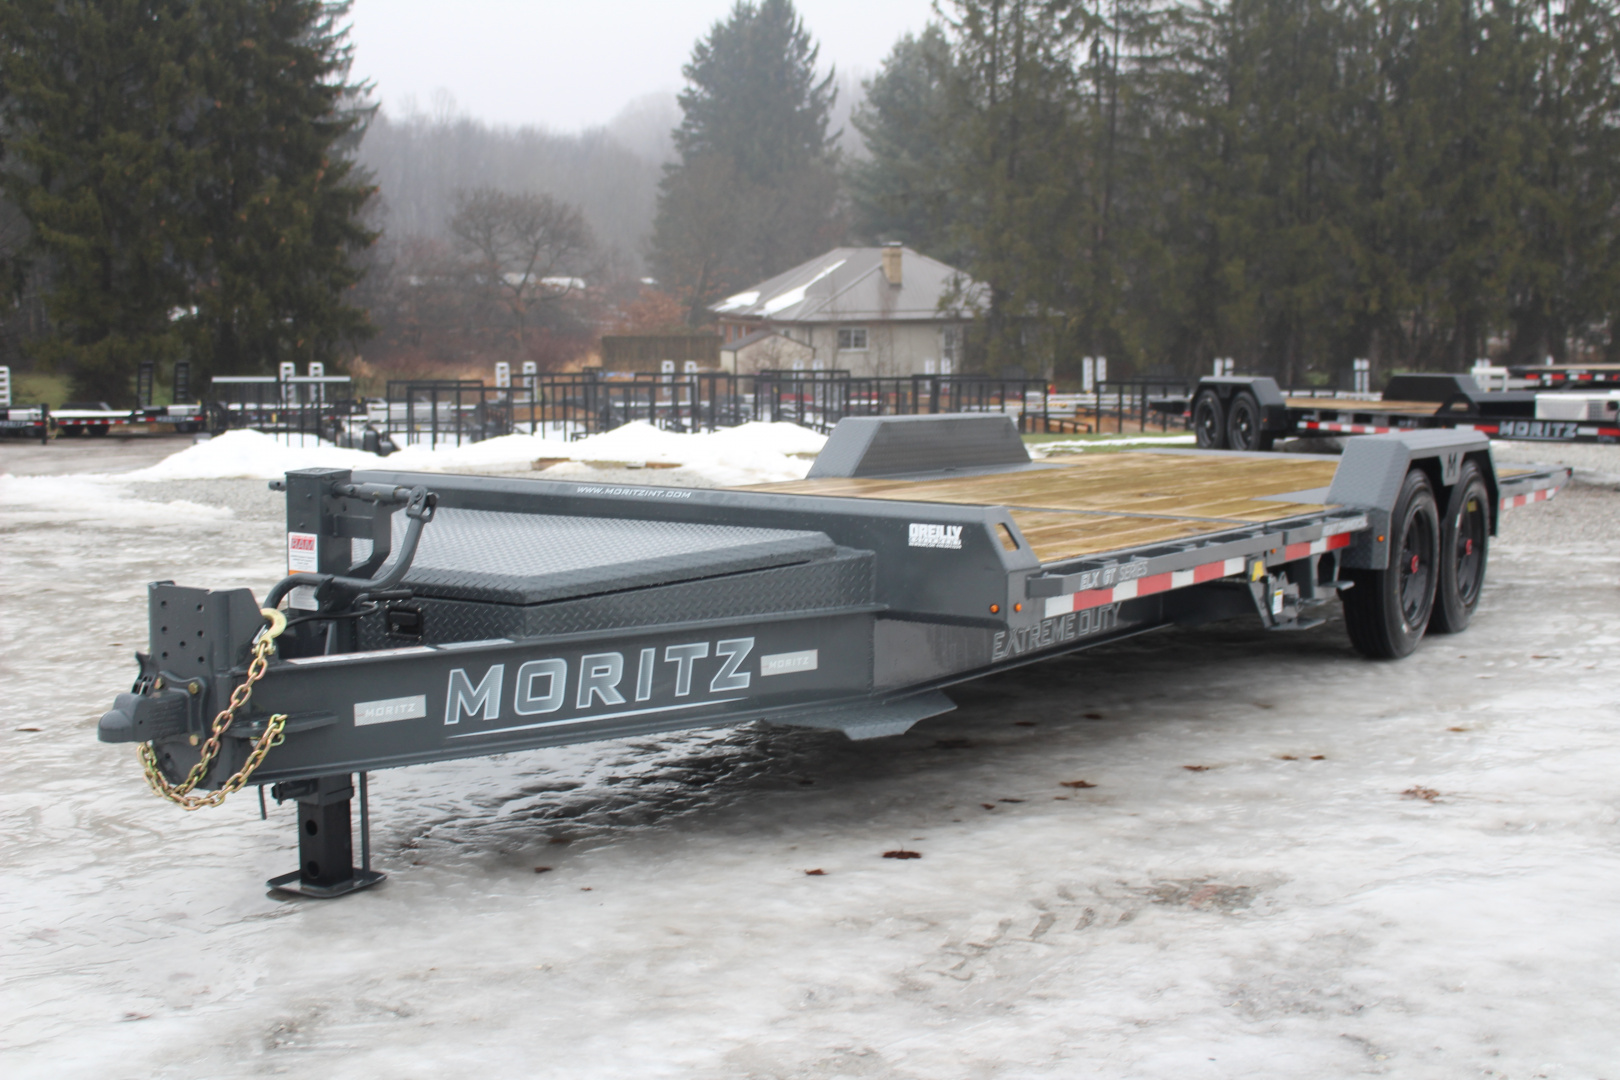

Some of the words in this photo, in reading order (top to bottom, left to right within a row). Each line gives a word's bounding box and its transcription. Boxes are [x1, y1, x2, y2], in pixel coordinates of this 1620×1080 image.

[1499, 421, 1578, 438] MORITZ
[991, 613, 1077, 663] EXTREME
[1078, 601, 1122, 637] DUTY
[769, 656, 809, 669] MORITZ
[444, 637, 755, 725] MORITZ
[364, 702, 416, 717] MORITZ
